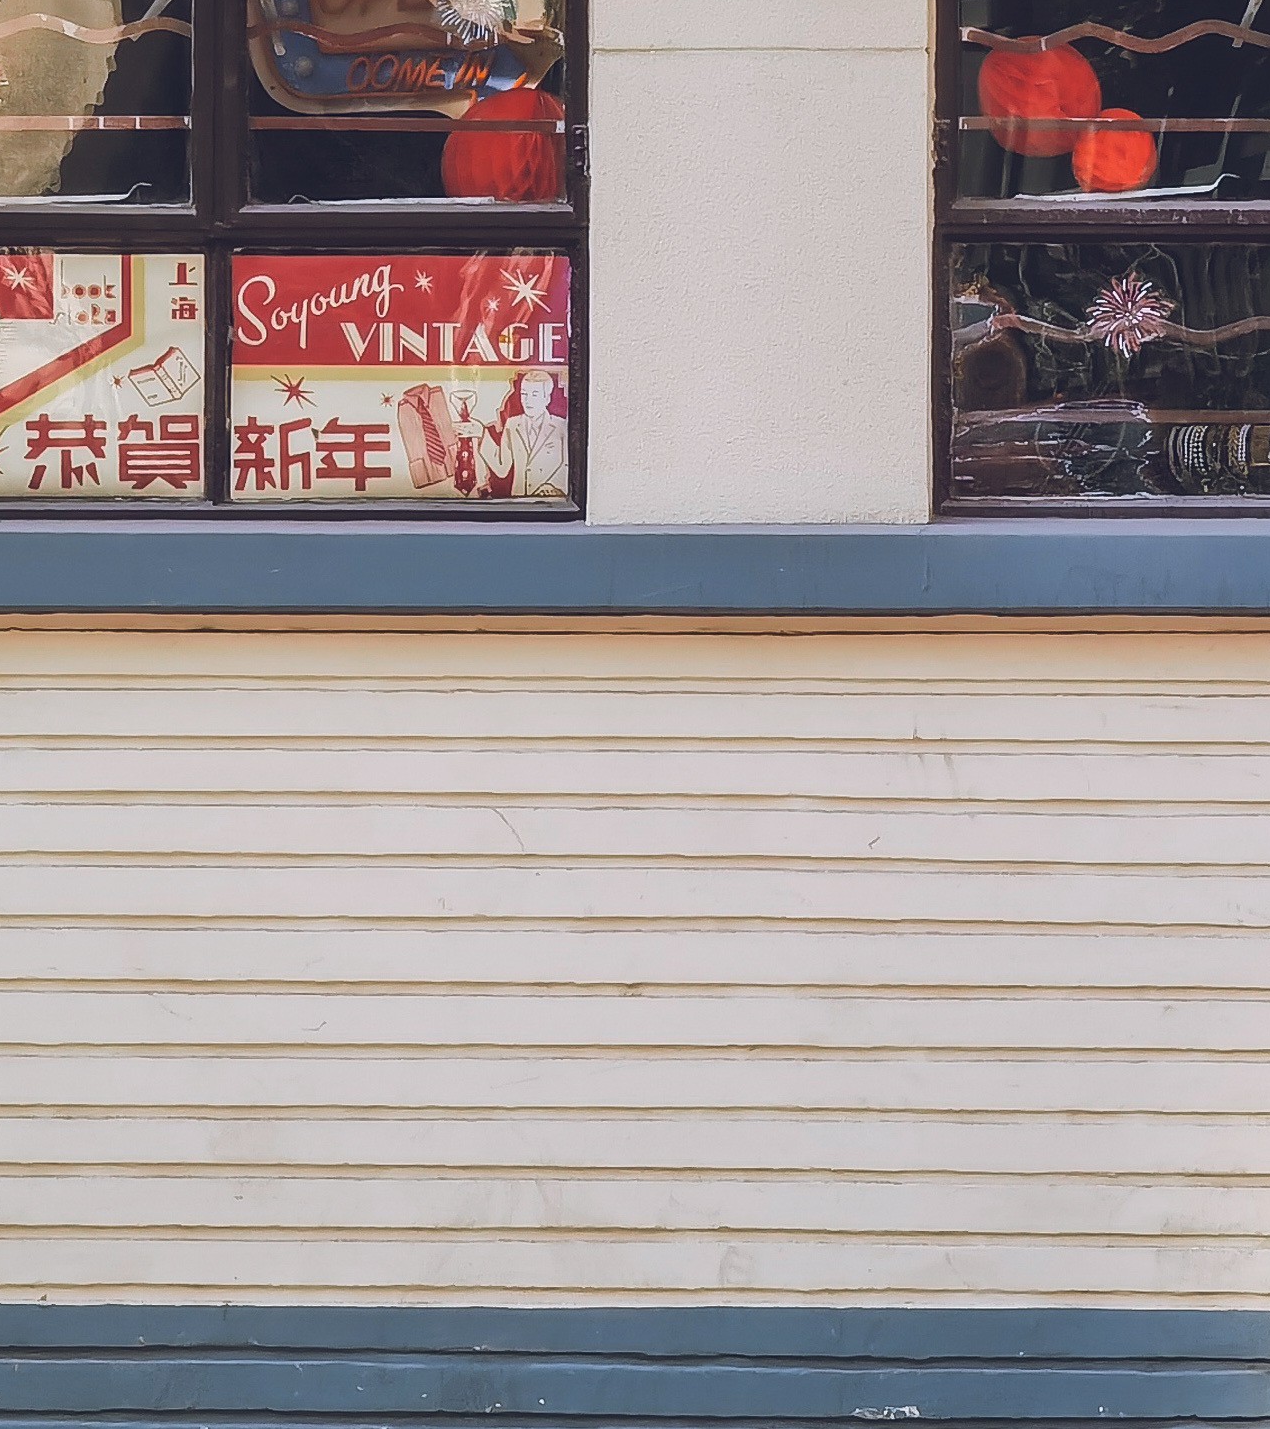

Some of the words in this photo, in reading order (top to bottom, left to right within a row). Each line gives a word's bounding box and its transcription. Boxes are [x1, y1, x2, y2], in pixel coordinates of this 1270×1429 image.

[168, 262, 199, 321] 上海
[237, 264, 405, 350] Soyoung
[340, 322, 566, 363] VINTAGE
[24, 414, 201, 490] 恭賀
[233, 416, 392, 491] 新年
